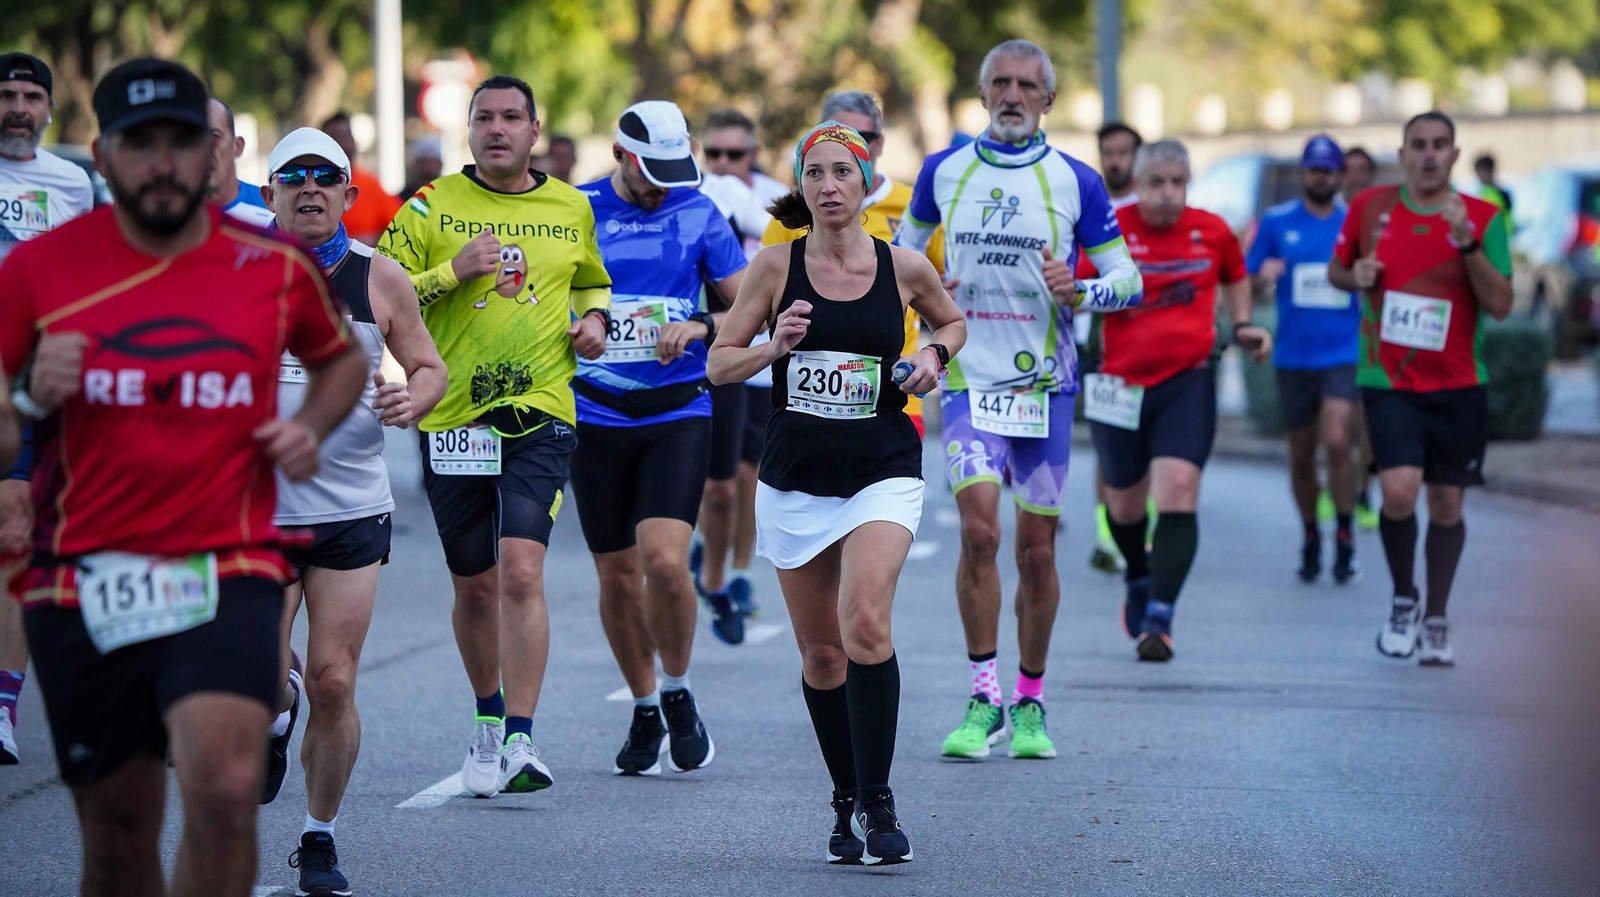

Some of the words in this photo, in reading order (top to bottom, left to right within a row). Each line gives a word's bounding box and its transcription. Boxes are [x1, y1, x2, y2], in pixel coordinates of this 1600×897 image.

[440, 213, 579, 243] Paparunners
[955, 232, 1047, 251] VETE-RUNNERS
[976, 252, 1021, 267] JEREZ
[797, 367, 843, 396] 230
[978, 394, 1015, 416] 447
[436, 429, 470, 453] 508
[97, 571, 155, 616] 151
